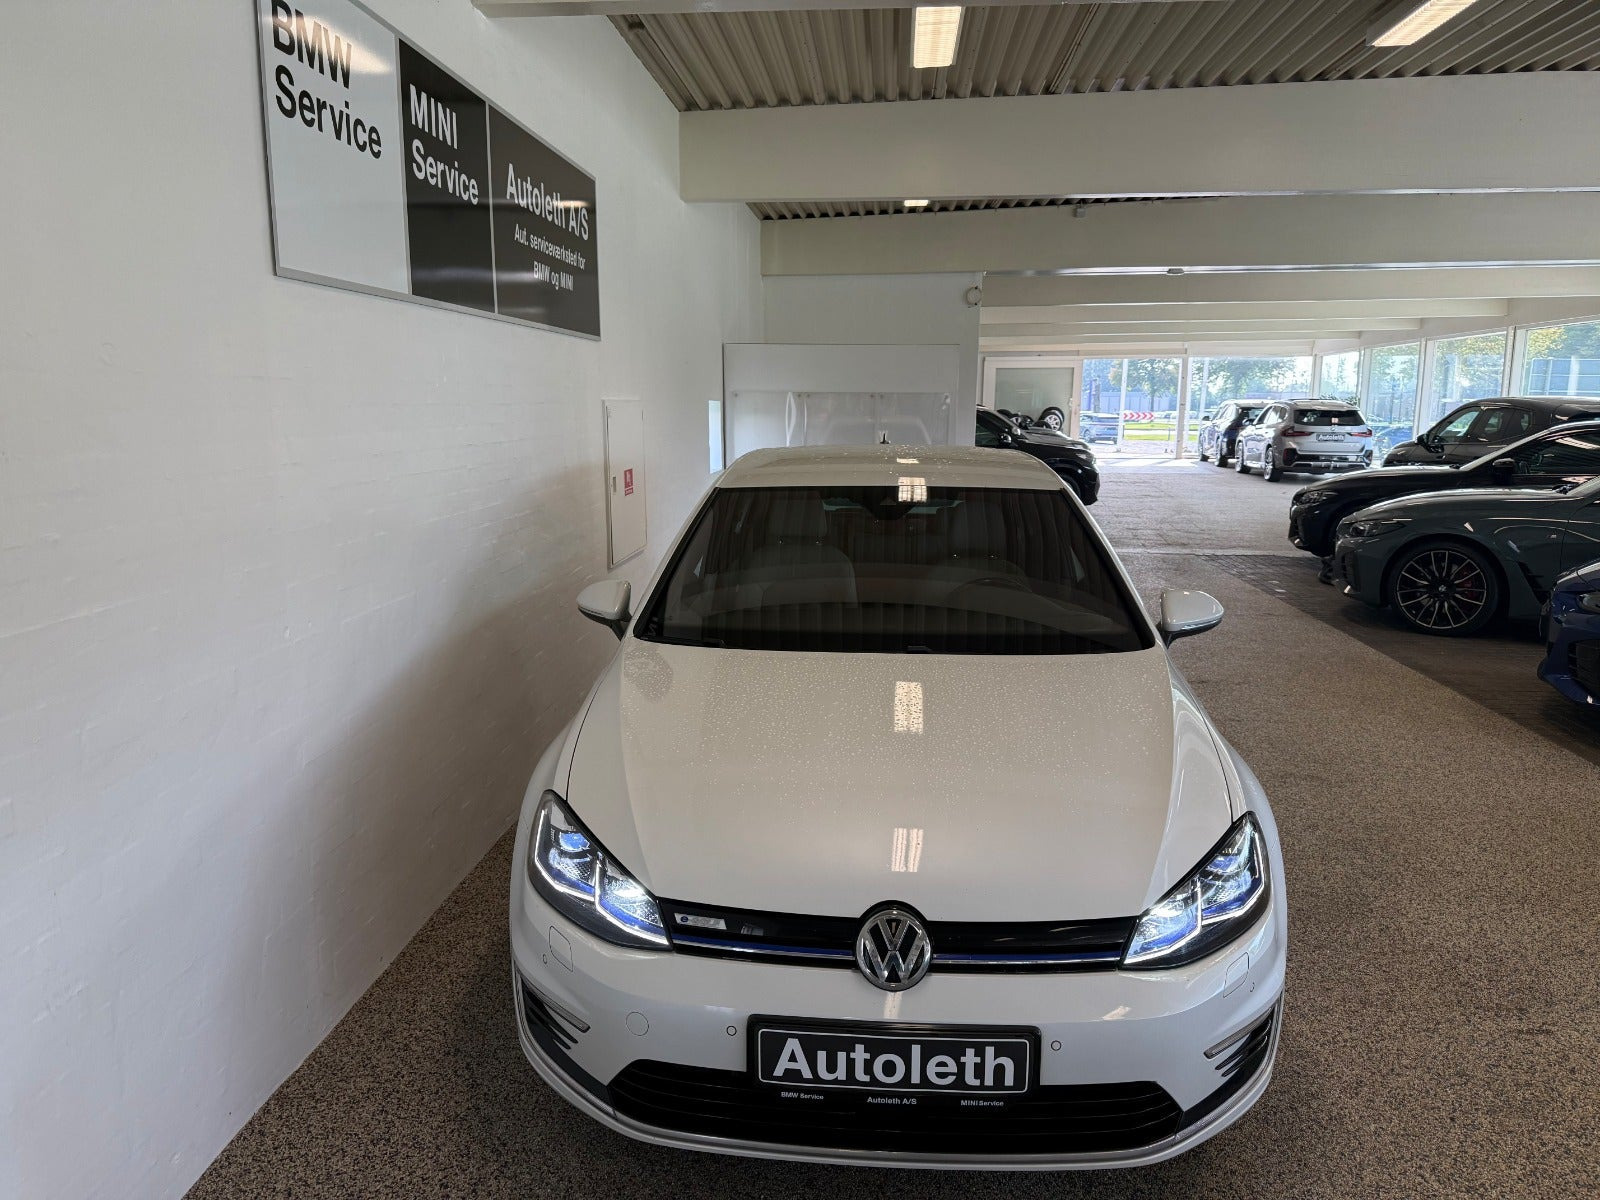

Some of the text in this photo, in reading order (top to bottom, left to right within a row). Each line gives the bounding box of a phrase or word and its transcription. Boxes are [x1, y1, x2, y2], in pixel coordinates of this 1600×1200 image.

[271, 0, 352, 89] BMW
[275, 64, 382, 159] Service
[409, 83, 458, 149] MINI
[412, 139, 479, 206] Service
[506, 163, 589, 241] Autoleth A/S
[514, 223, 529, 246] Aut.
[577, 252, 586, 270] for
[533, 260, 574, 292] BMW og MINI
[772, 1037, 1016, 1088] Autoleth
[780, 1091, 825, 1101] BMW Service
[866, 1096, 918, 1106] Autoleth A/S
[960, 1099, 1005, 1108] MINI Service
